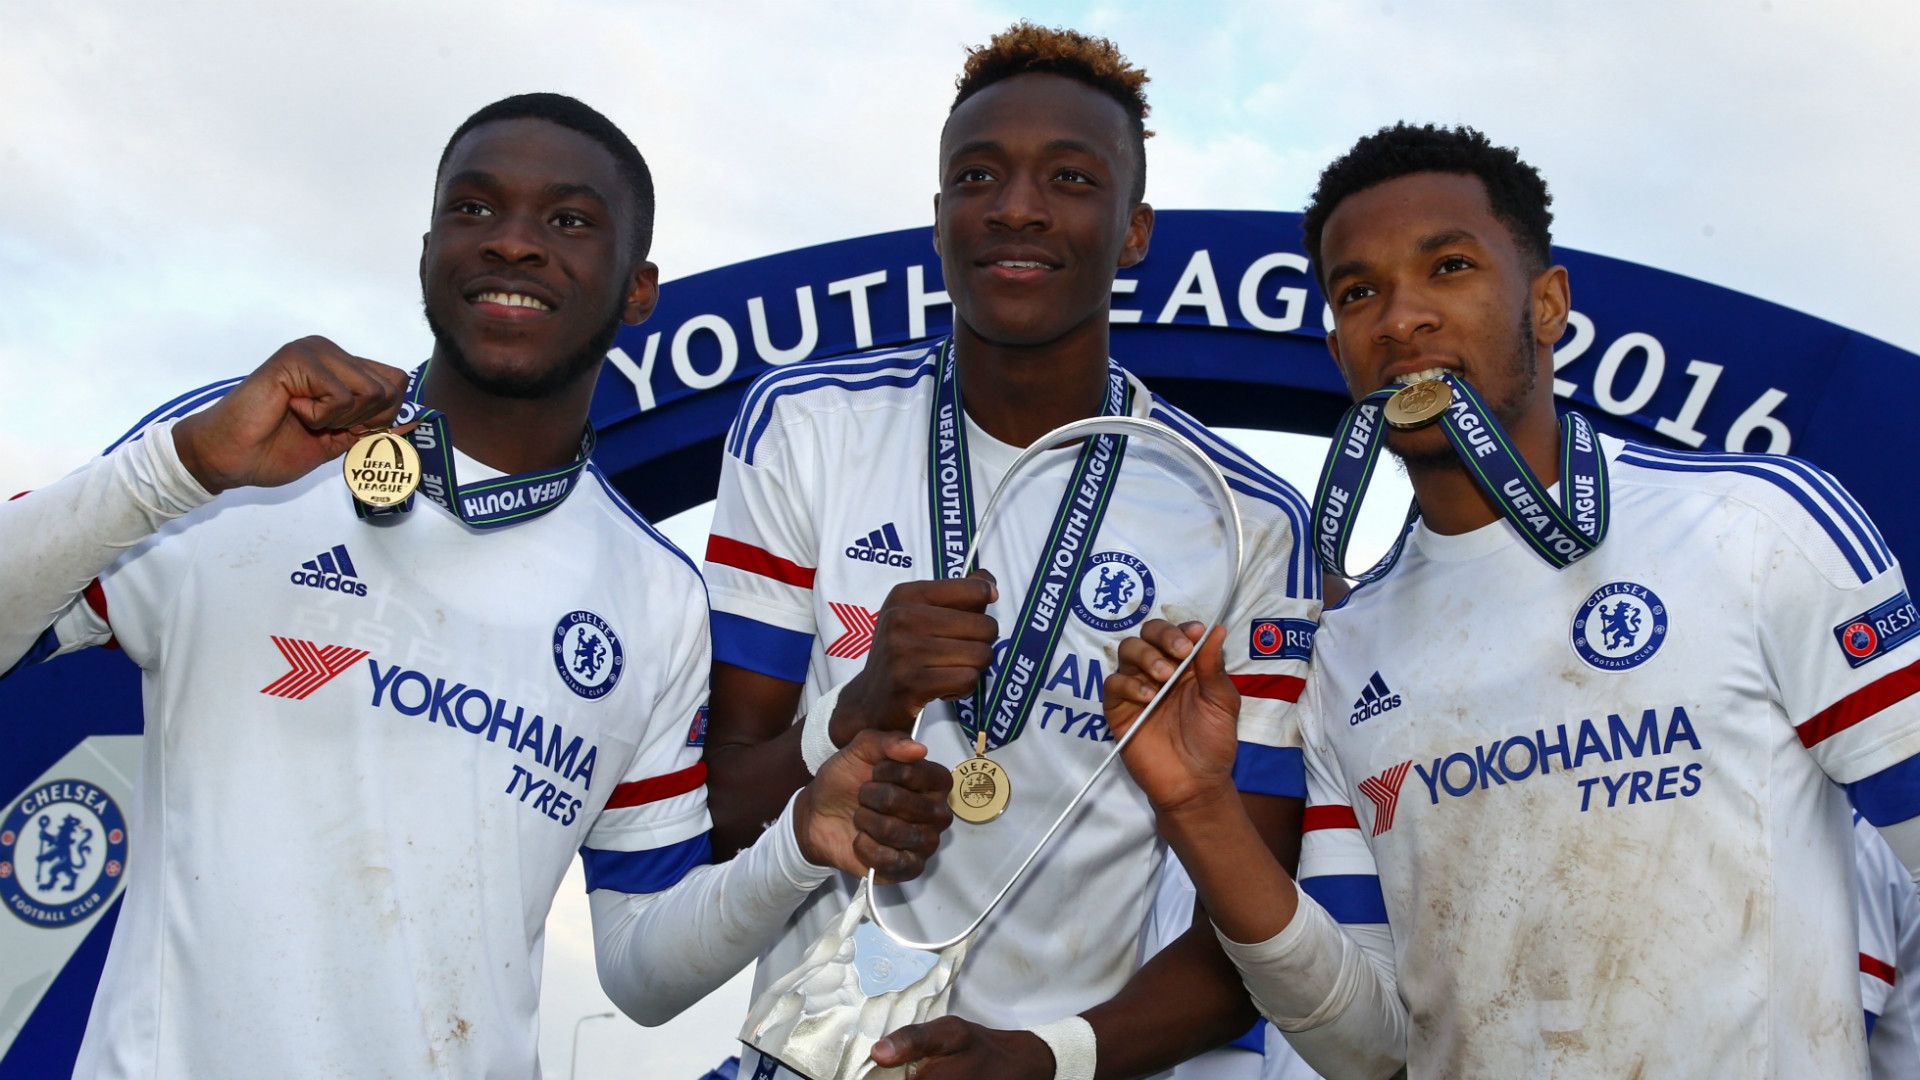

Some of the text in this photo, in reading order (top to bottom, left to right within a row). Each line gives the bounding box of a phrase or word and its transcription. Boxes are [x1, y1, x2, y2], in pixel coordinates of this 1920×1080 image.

[607, 265, 954, 412] YOUTH
[1553, 309, 1791, 455] 2016
[1345, 403, 1378, 459] UEFA
[352, 469, 412, 484] YOUTH
[363, 460, 391, 469] UEFA
[358, 482, 402, 493] LEAGUE
[464, 478, 568, 517] UEFA YOUTH
[940, 404, 965, 579] UEFA YOUTH LEAG
[1031, 434, 1114, 633] UEFA YOUTH LEAGUE
[1503, 478, 1585, 562] UEFA YOU
[845, 546, 912, 568] adidas
[1092, 553, 1149, 578] CHELSEA
[290, 568, 368, 597] adidas
[1586, 583, 1649, 607] CHELSEA
[570, 612, 616, 645] CHELSEA
[1075, 604, 1134, 629] FOOTBALL CLUB
[1875, 603, 1916, 639] RESP
[1588, 644, 1654, 667] FOOTBALL CLUB
[992, 654, 1035, 739] LEAGUE
[1350, 692, 1402, 726] adidas
[368, 658, 598, 791] YOKOHAMA
[1040, 701, 1115, 741] TYR
[959, 762, 997, 777] UEFA
[1414, 706, 1702, 805] YOKOHAMA
[21, 783, 108, 815] CHELSEA
[504, 764, 583, 826] TYRES
[1577, 763, 1703, 812] TYRES
[10, 892, 101, 921] FOOTBALL CLUB
